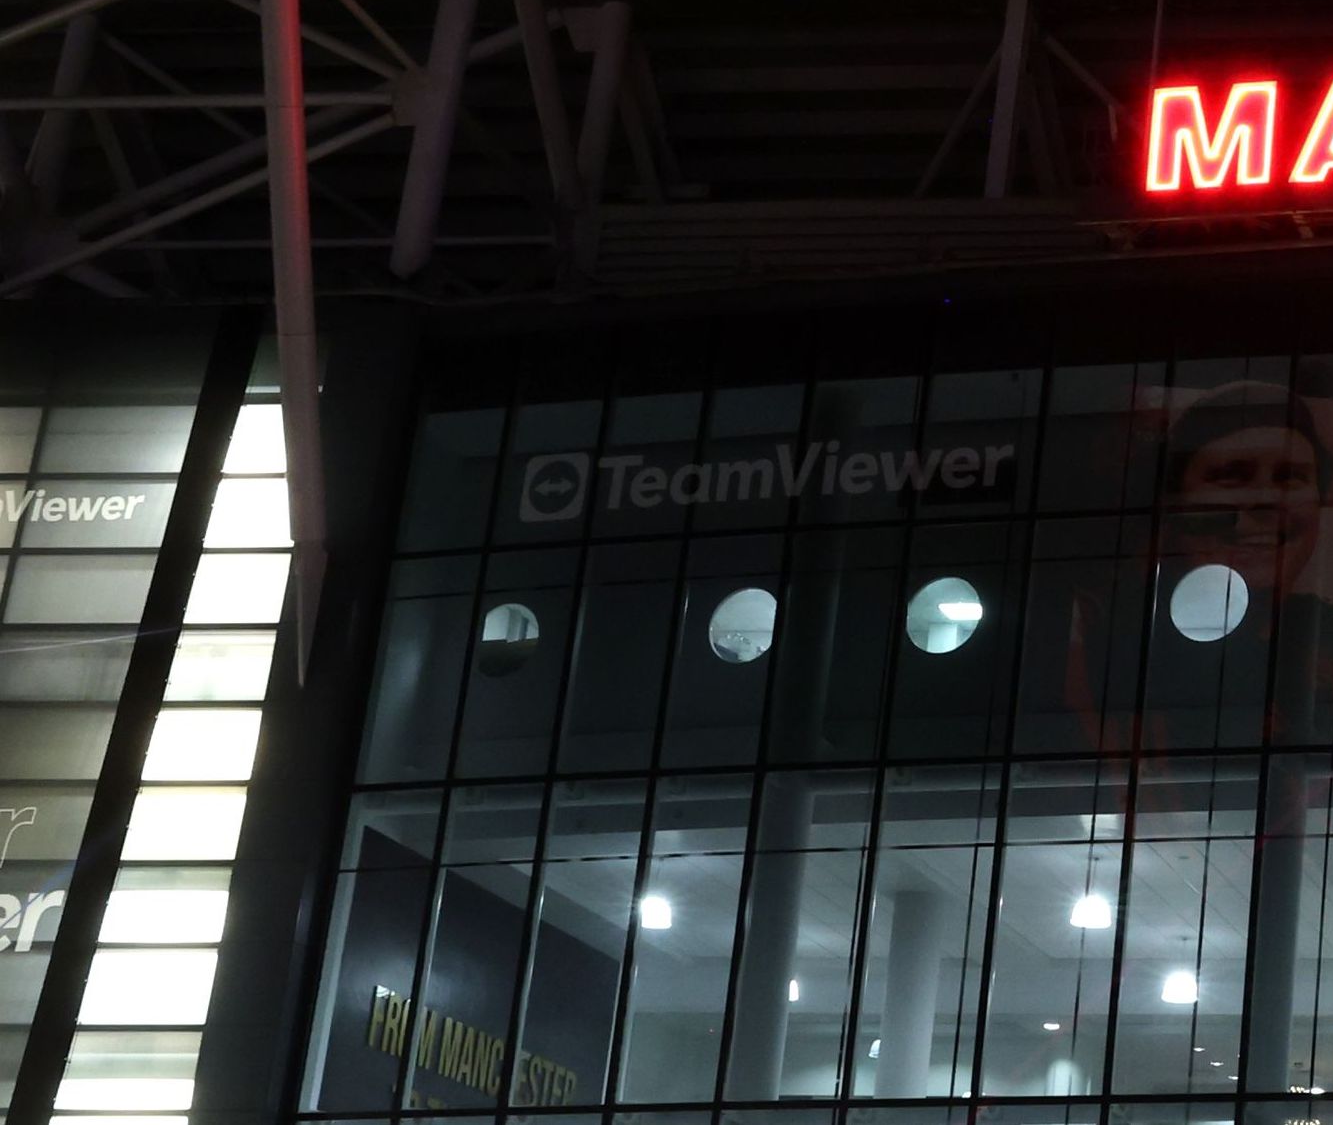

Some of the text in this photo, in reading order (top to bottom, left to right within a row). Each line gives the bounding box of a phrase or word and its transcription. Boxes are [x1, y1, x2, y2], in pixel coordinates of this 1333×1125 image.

[0, 489, 146, 522] Viewer
[598, 439, 1015, 511] TeamViewer
[436, 1015, 578, 1107] MANCESTER
